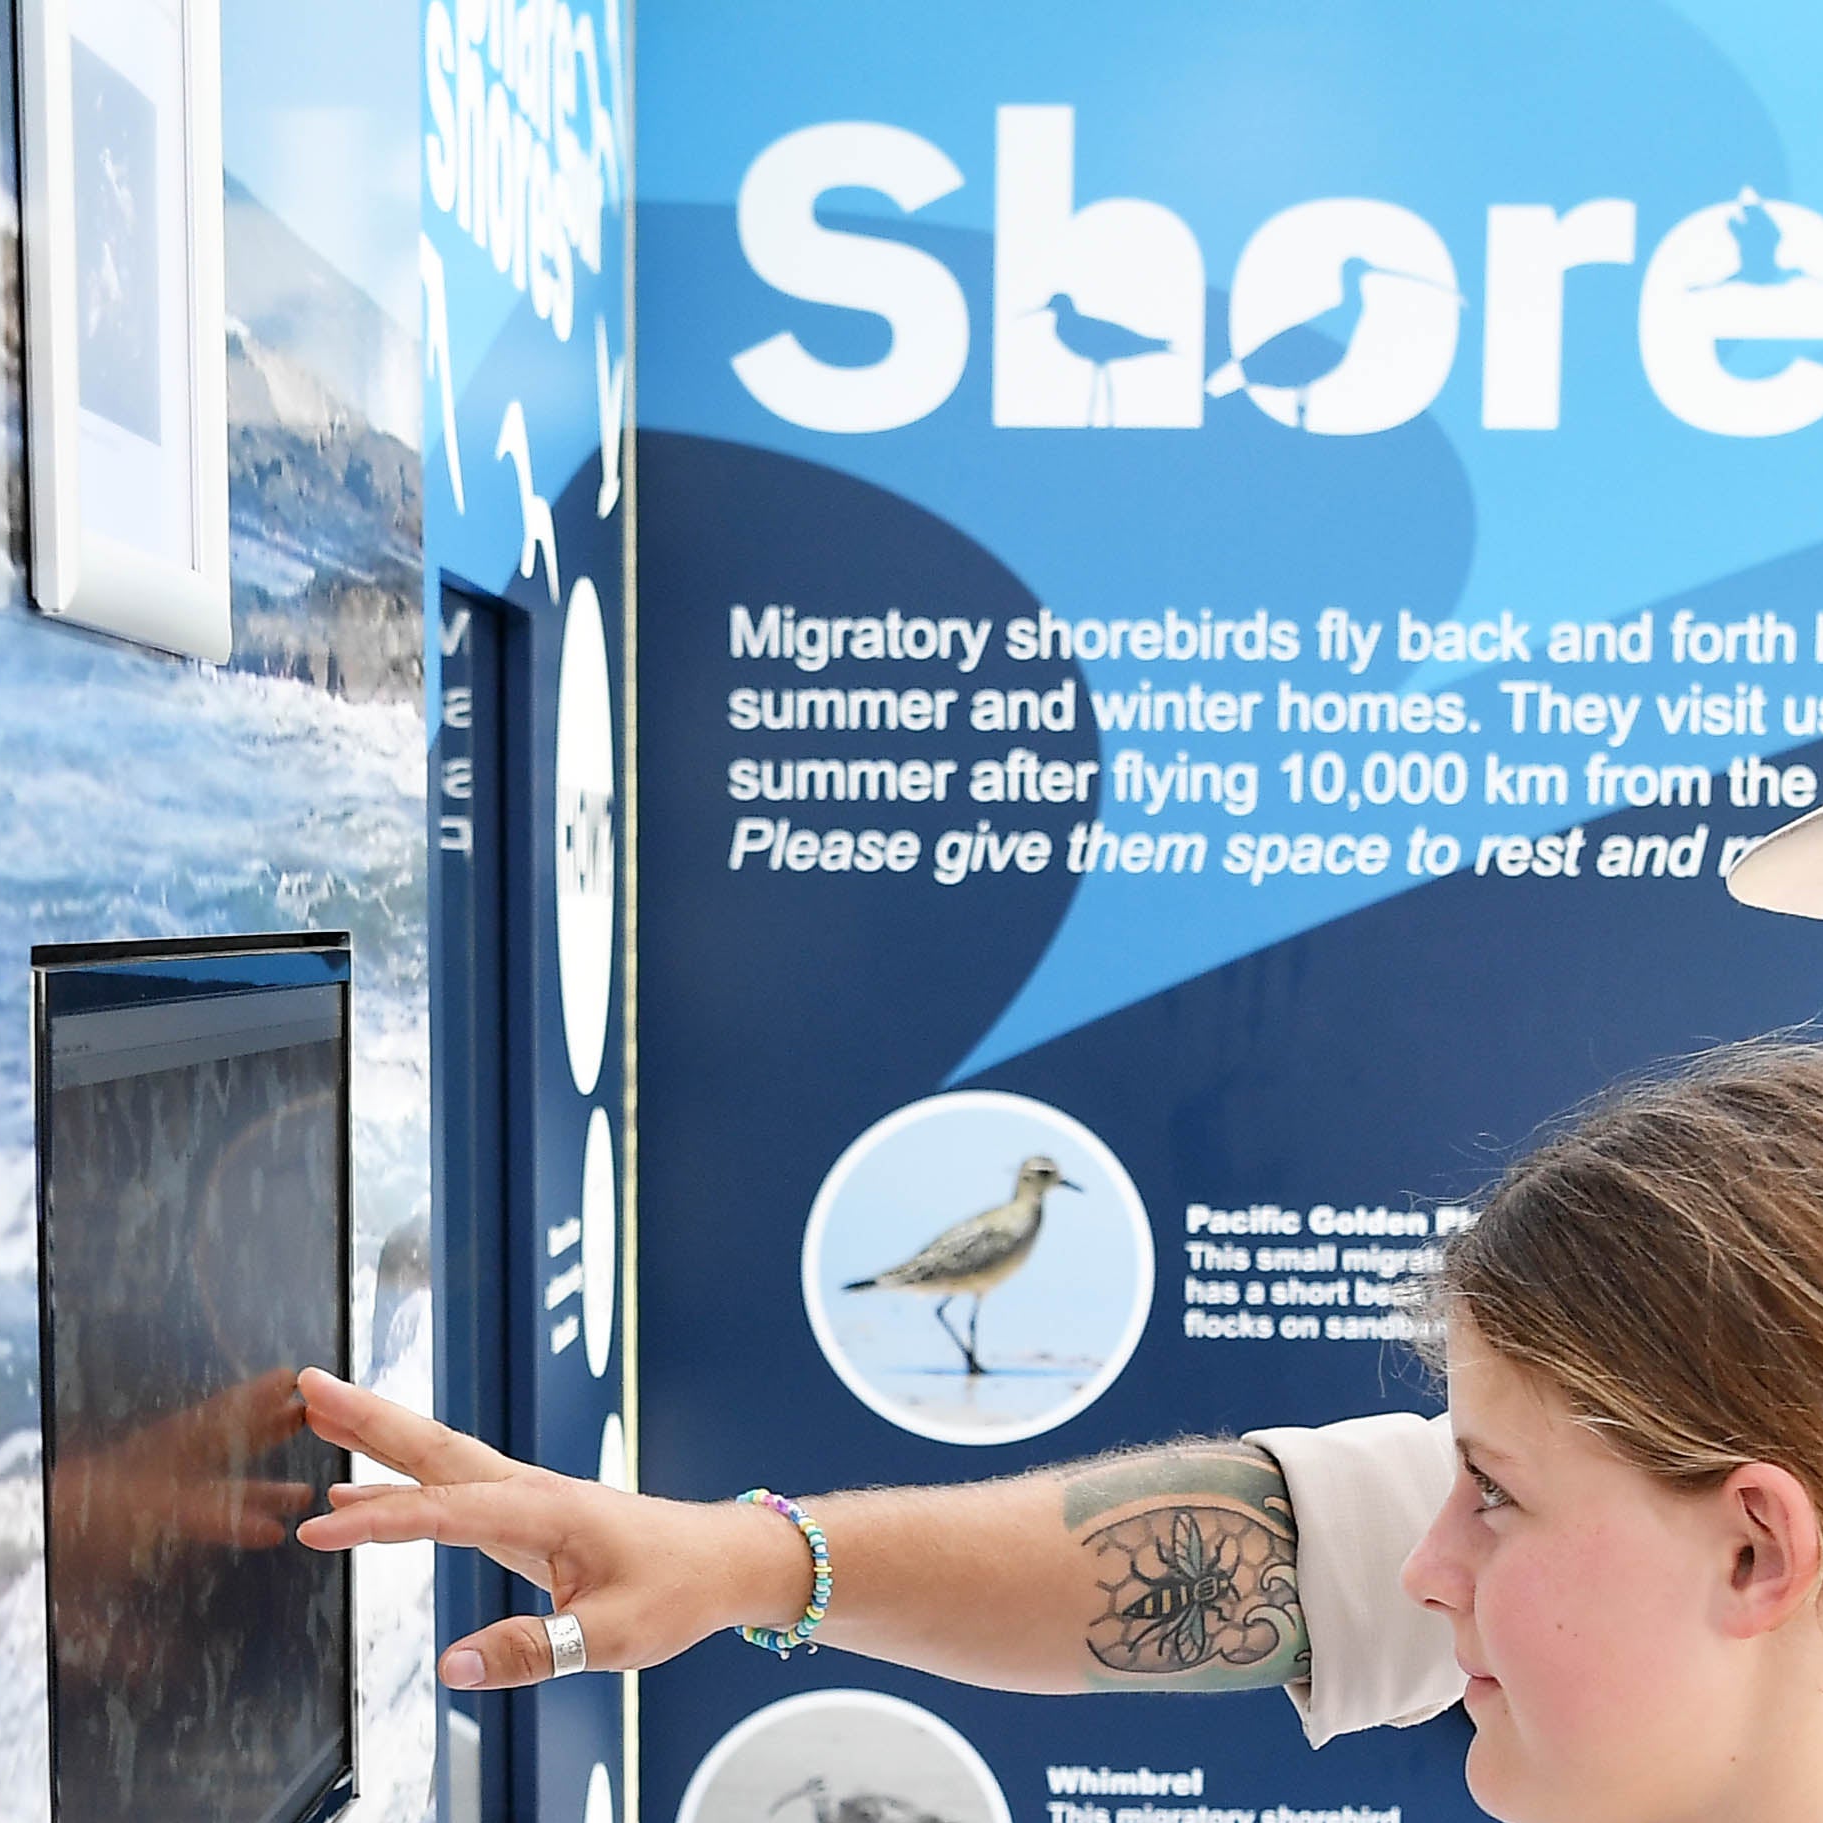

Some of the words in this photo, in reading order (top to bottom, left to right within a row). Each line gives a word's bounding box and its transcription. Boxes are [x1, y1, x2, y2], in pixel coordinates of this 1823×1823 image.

[730, 606, 992, 672] Migratory
[1006, 608, 1300, 661] shorebirds
[1318, 609, 1382, 674] fly
[1398, 610, 1531, 663] back
[1547, 611, 1653, 664] and
[1670, 610, 1797, 664] forth
[728, 688, 958, 732] summer
[970, 679, 1076, 732] and
[1090, 681, 1264, 733] winter
[1278, 680, 1480, 735] homes.
[1500, 680, 1642, 748] They
[1656, 683, 1768, 736] visit
[728, 759, 957, 802] summer
[969, 747, 1099, 803] after
[1112, 749, 1258, 816] flying
[1281, 751, 1468, 811] 10,000
[1485, 753, 1569, 806] km
[1584, 752, 1712, 807] from
[1729, 753, 1818, 808] the
[728, 818, 920, 872] Please
[934, 820, 1052, 885] give
[1067, 822, 1208, 875] them
[1222, 832, 1390, 886] space
[1406, 825, 1461, 877] to
[1475, 825, 1587, 877] rest
[1596, 825, 1710, 878] and
[1184, 1203, 1303, 1236] Pacific
[1306, 1203, 1430, 1237] Golden
[1184, 1240, 1253, 1273] This
[1255, 1242, 1338, 1274] small
[1341, 1242, 1445, 1280] migrat
[1184, 1275, 1240, 1306] has
[1244, 1280, 1267, 1306] a
[1269, 1275, 1351, 1307] short
[1183, 1308, 1275, 1341] flocks
[1278, 1314, 1321, 1341] on
[1045, 1764, 1205, 1797] Whimbrel
